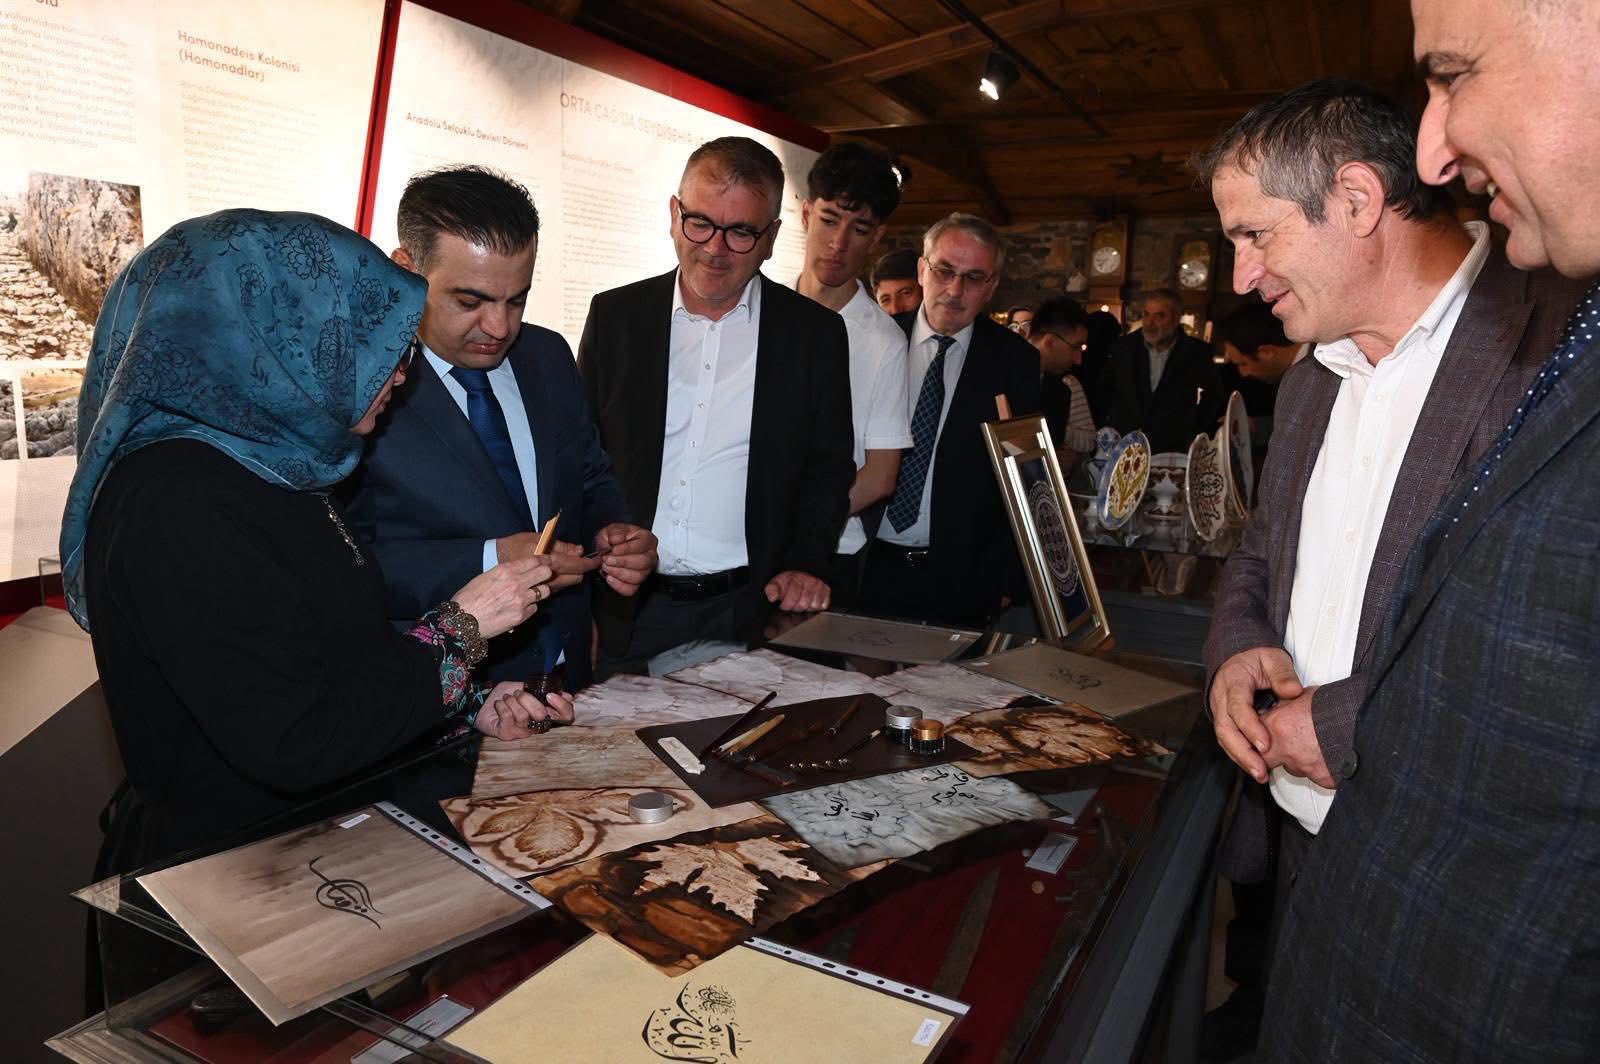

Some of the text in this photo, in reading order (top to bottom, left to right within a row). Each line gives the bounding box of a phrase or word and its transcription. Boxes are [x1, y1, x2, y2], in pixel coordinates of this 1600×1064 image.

[178, 30, 255, 61] Homonadeis
[179, 47, 265, 82] (Homonadlar)
[560, 92, 593, 114] ORTA
[406, 112, 441, 129] Anadolu
[442, 120, 475, 137] Selçuklu
